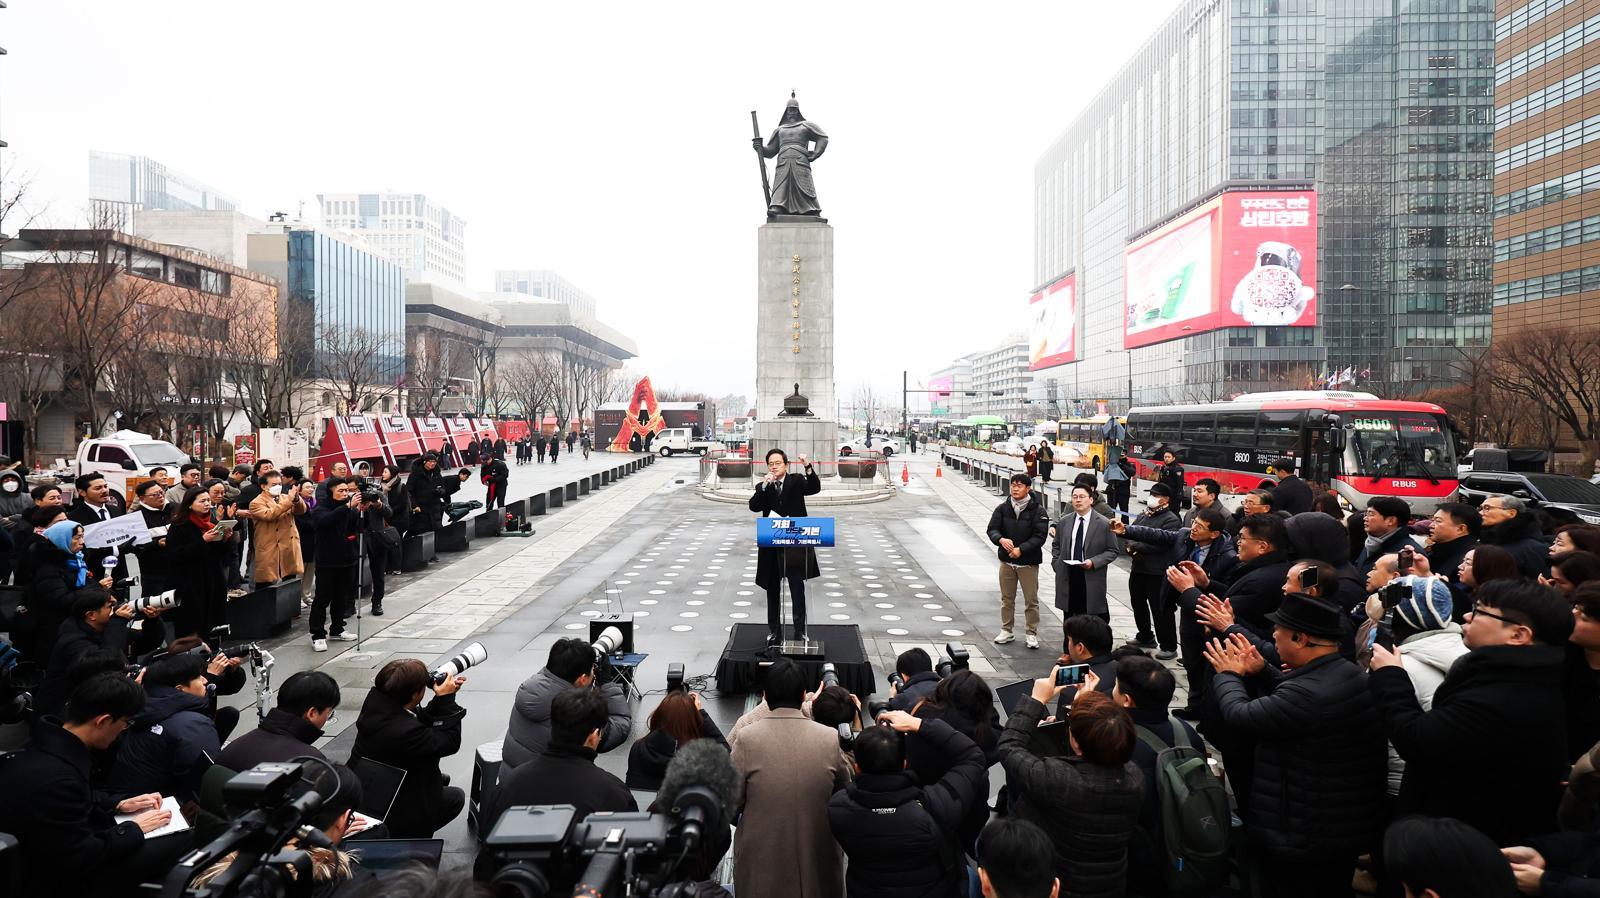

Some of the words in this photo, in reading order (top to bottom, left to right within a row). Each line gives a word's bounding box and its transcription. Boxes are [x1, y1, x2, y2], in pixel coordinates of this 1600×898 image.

[1240, 211, 1310, 227] 삼립호빵
[1354, 418, 1391, 430] 8600
[1234, 452, 1250, 463] 8600
[801, 526, 820, 536] 기본
